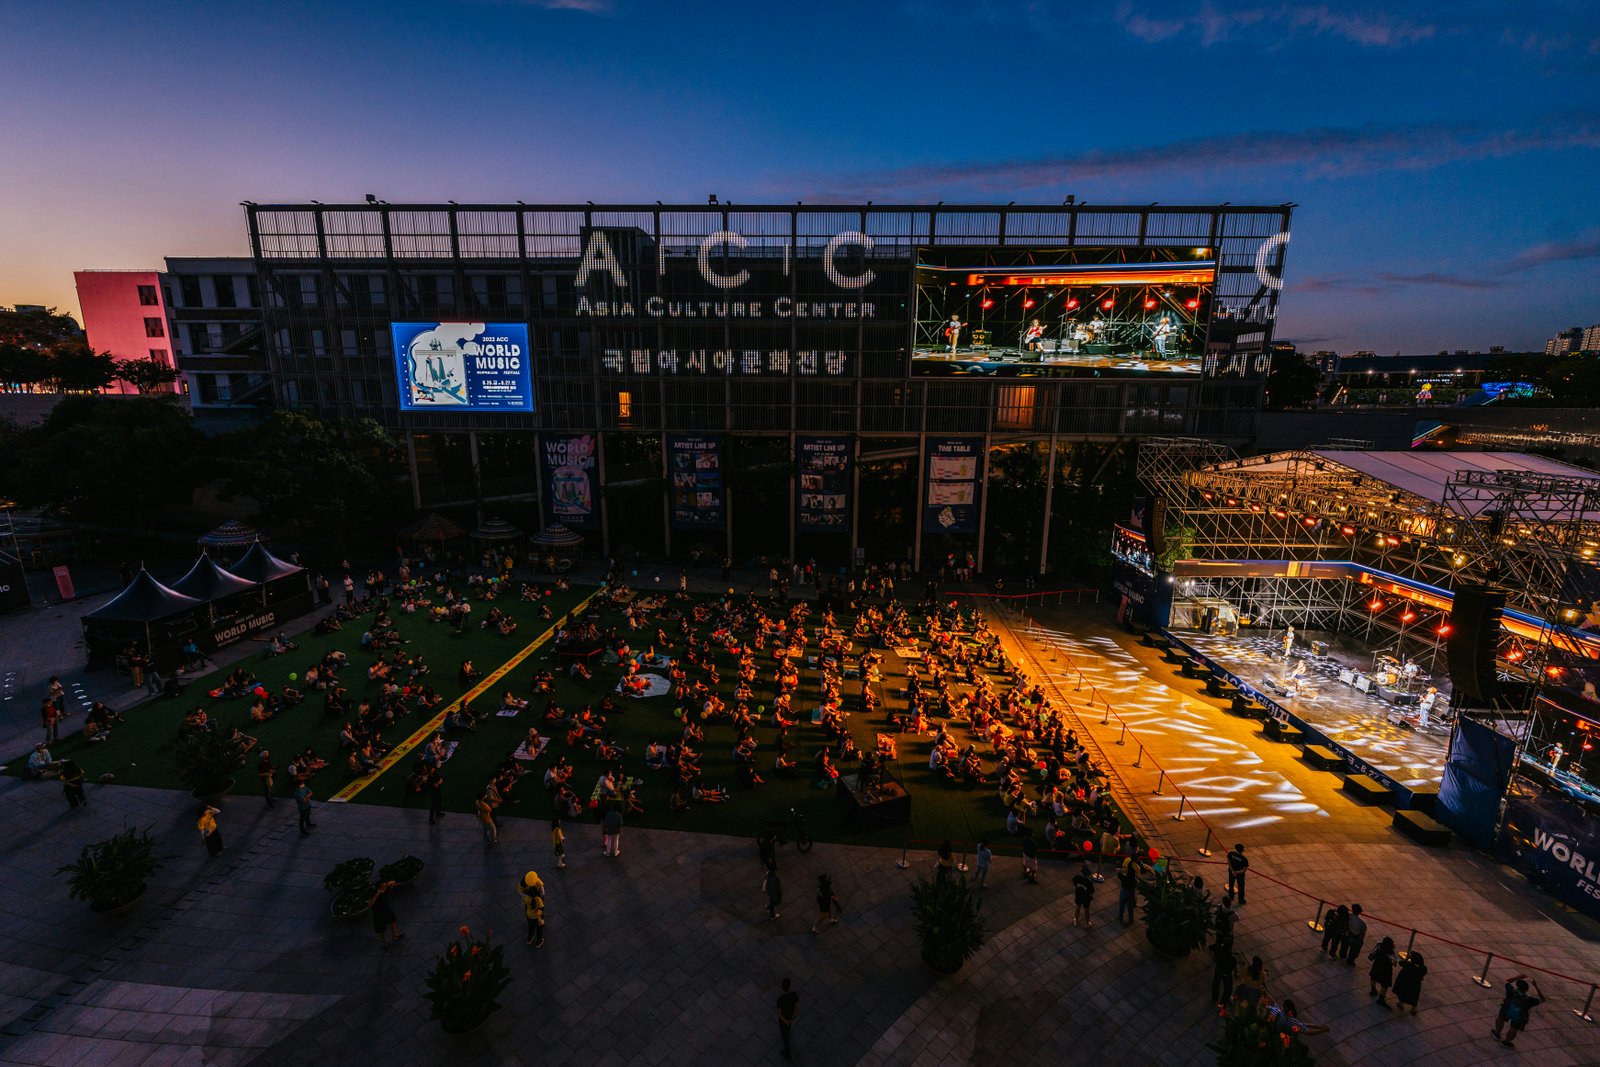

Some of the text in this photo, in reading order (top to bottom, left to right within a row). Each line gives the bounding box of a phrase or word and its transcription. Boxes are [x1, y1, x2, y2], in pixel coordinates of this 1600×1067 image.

[475, 344, 521, 357] WORLD
[475, 357, 521, 370] MUSIC
[545, 441, 588, 454] WORLD
[674, 441, 694, 449] ARTIST
[803, 443, 823, 452] ARTIST
[938, 444, 972, 452] TIME TABLE
[546, 453, 588, 466] MUSIC
[214, 623, 248, 643] WORLD
[248, 611, 276, 630] MUSIC
[1534, 827, 1600, 885] WORL
